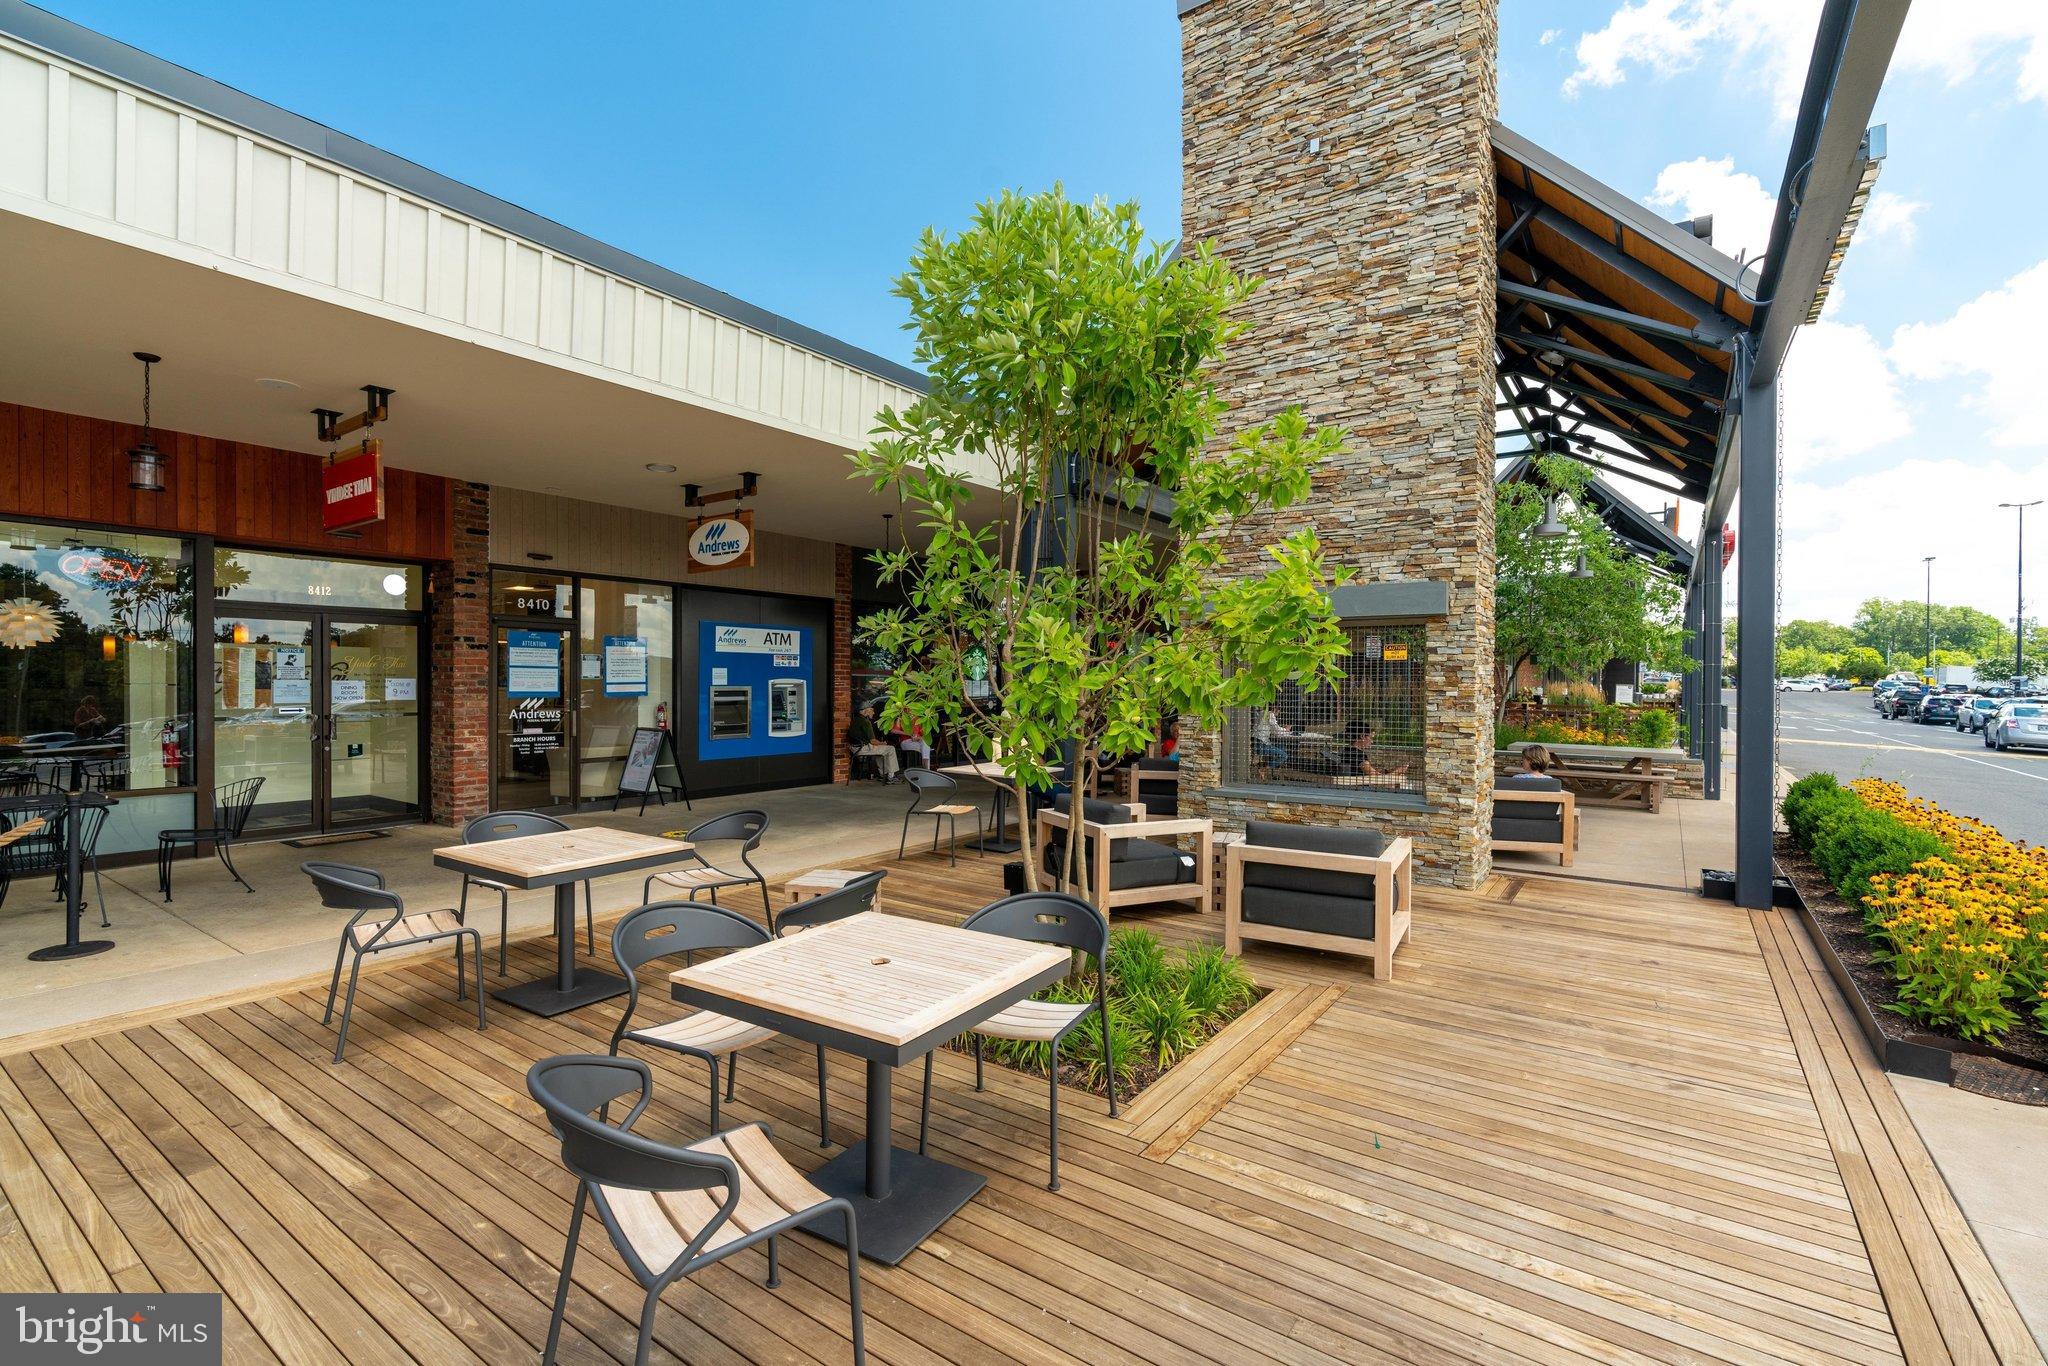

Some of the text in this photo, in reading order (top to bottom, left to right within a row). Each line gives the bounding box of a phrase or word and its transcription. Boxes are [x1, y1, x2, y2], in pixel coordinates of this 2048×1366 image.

[698, 539, 740, 554] Andrews
[308, 585, 332, 596] 8412
[517, 598, 550, 611] 8410
[717, 635, 747, 644] Andrews
[763, 632, 792, 646] ATM
[392, 688, 398, 696] 9
[508, 709, 561, 719] Andrews
